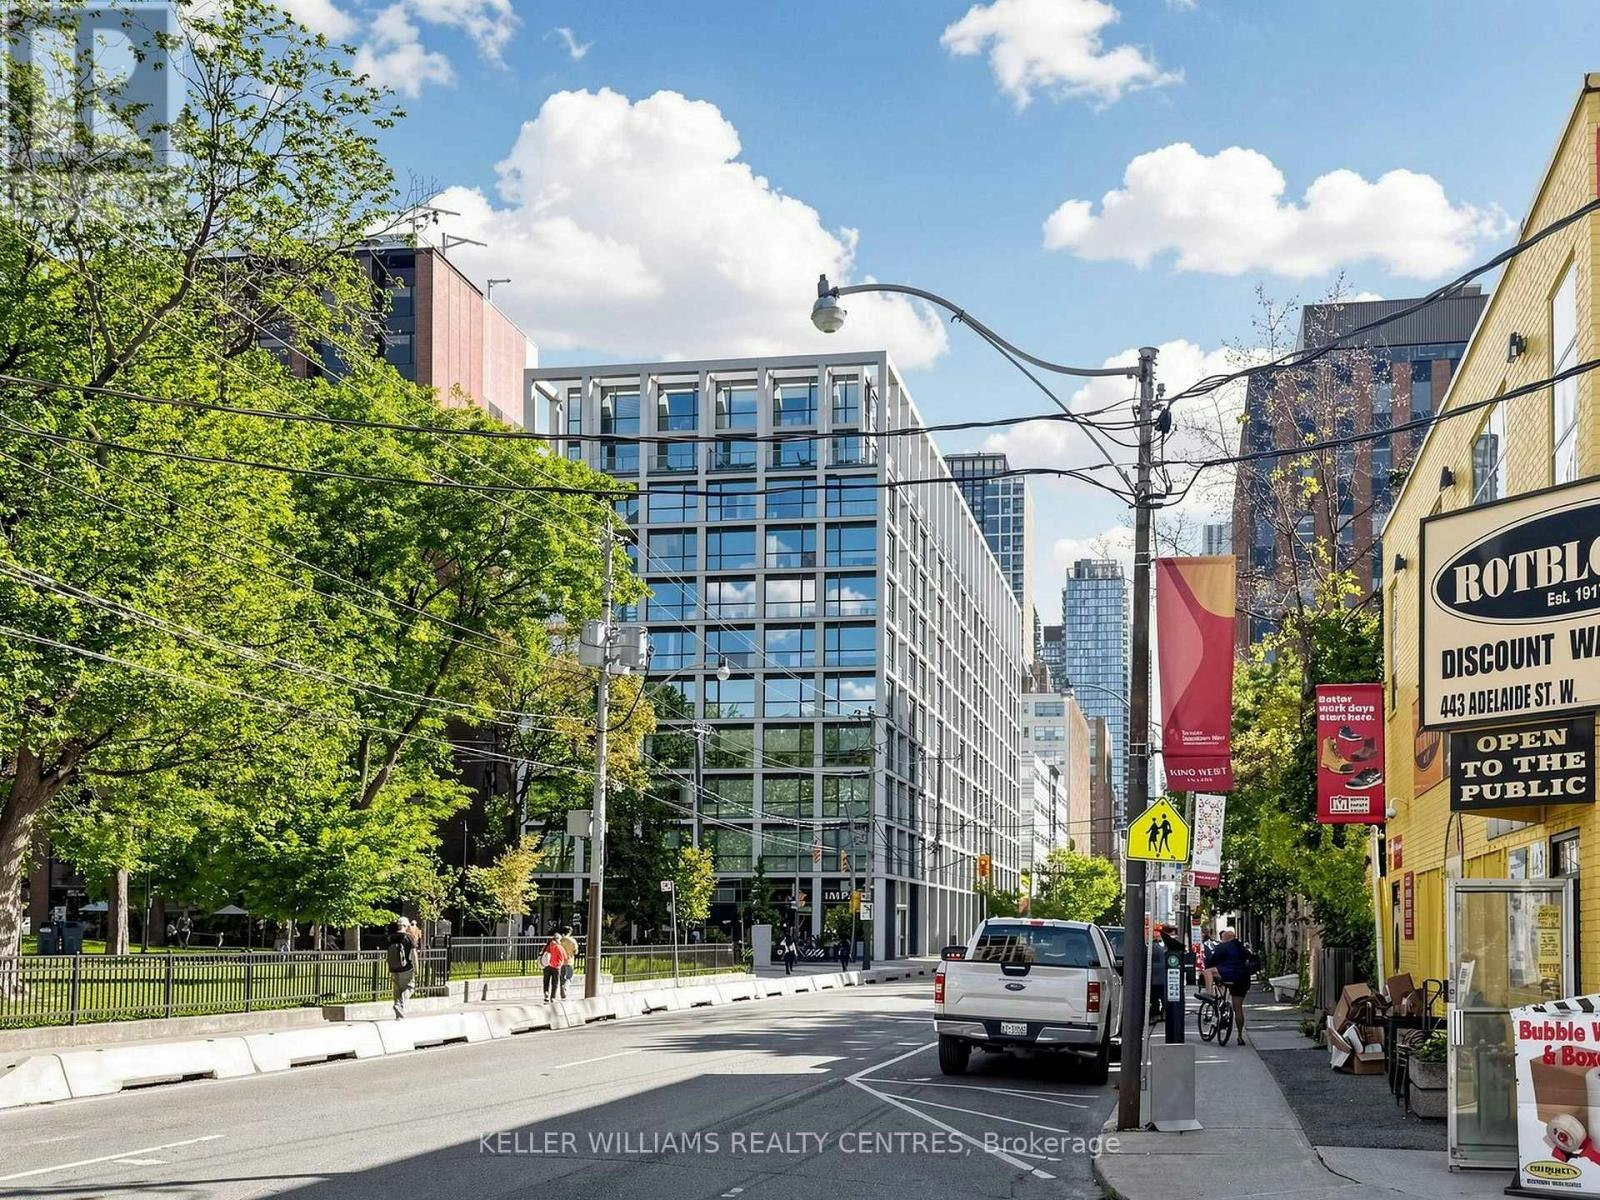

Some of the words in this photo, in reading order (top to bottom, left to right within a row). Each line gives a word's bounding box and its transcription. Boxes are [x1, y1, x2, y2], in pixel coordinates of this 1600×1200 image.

[1547, 591, 1570, 607] Est.
[1576, 584, 1600, 601] 191
[1442, 633, 1555, 679] DISCOUNT
[1319, 704, 1346, 712] work
[1440, 693, 1465, 718] 443
[1469, 684, 1531, 715] ADELAIDE
[1535, 682, 1556, 707] ST.
[1560, 679, 1577, 704] W.
[1476, 728, 1568, 752] OPEN
[1460, 759, 1503, 778] TO
[1513, 751, 1586, 773] THE
[1460, 776, 1586, 801] PUBLIC
[1519, 1020, 1586, 1042] Bubble
[1543, 1045, 1556, 1065] &
[1562, 1045, 1600, 1067] Box
